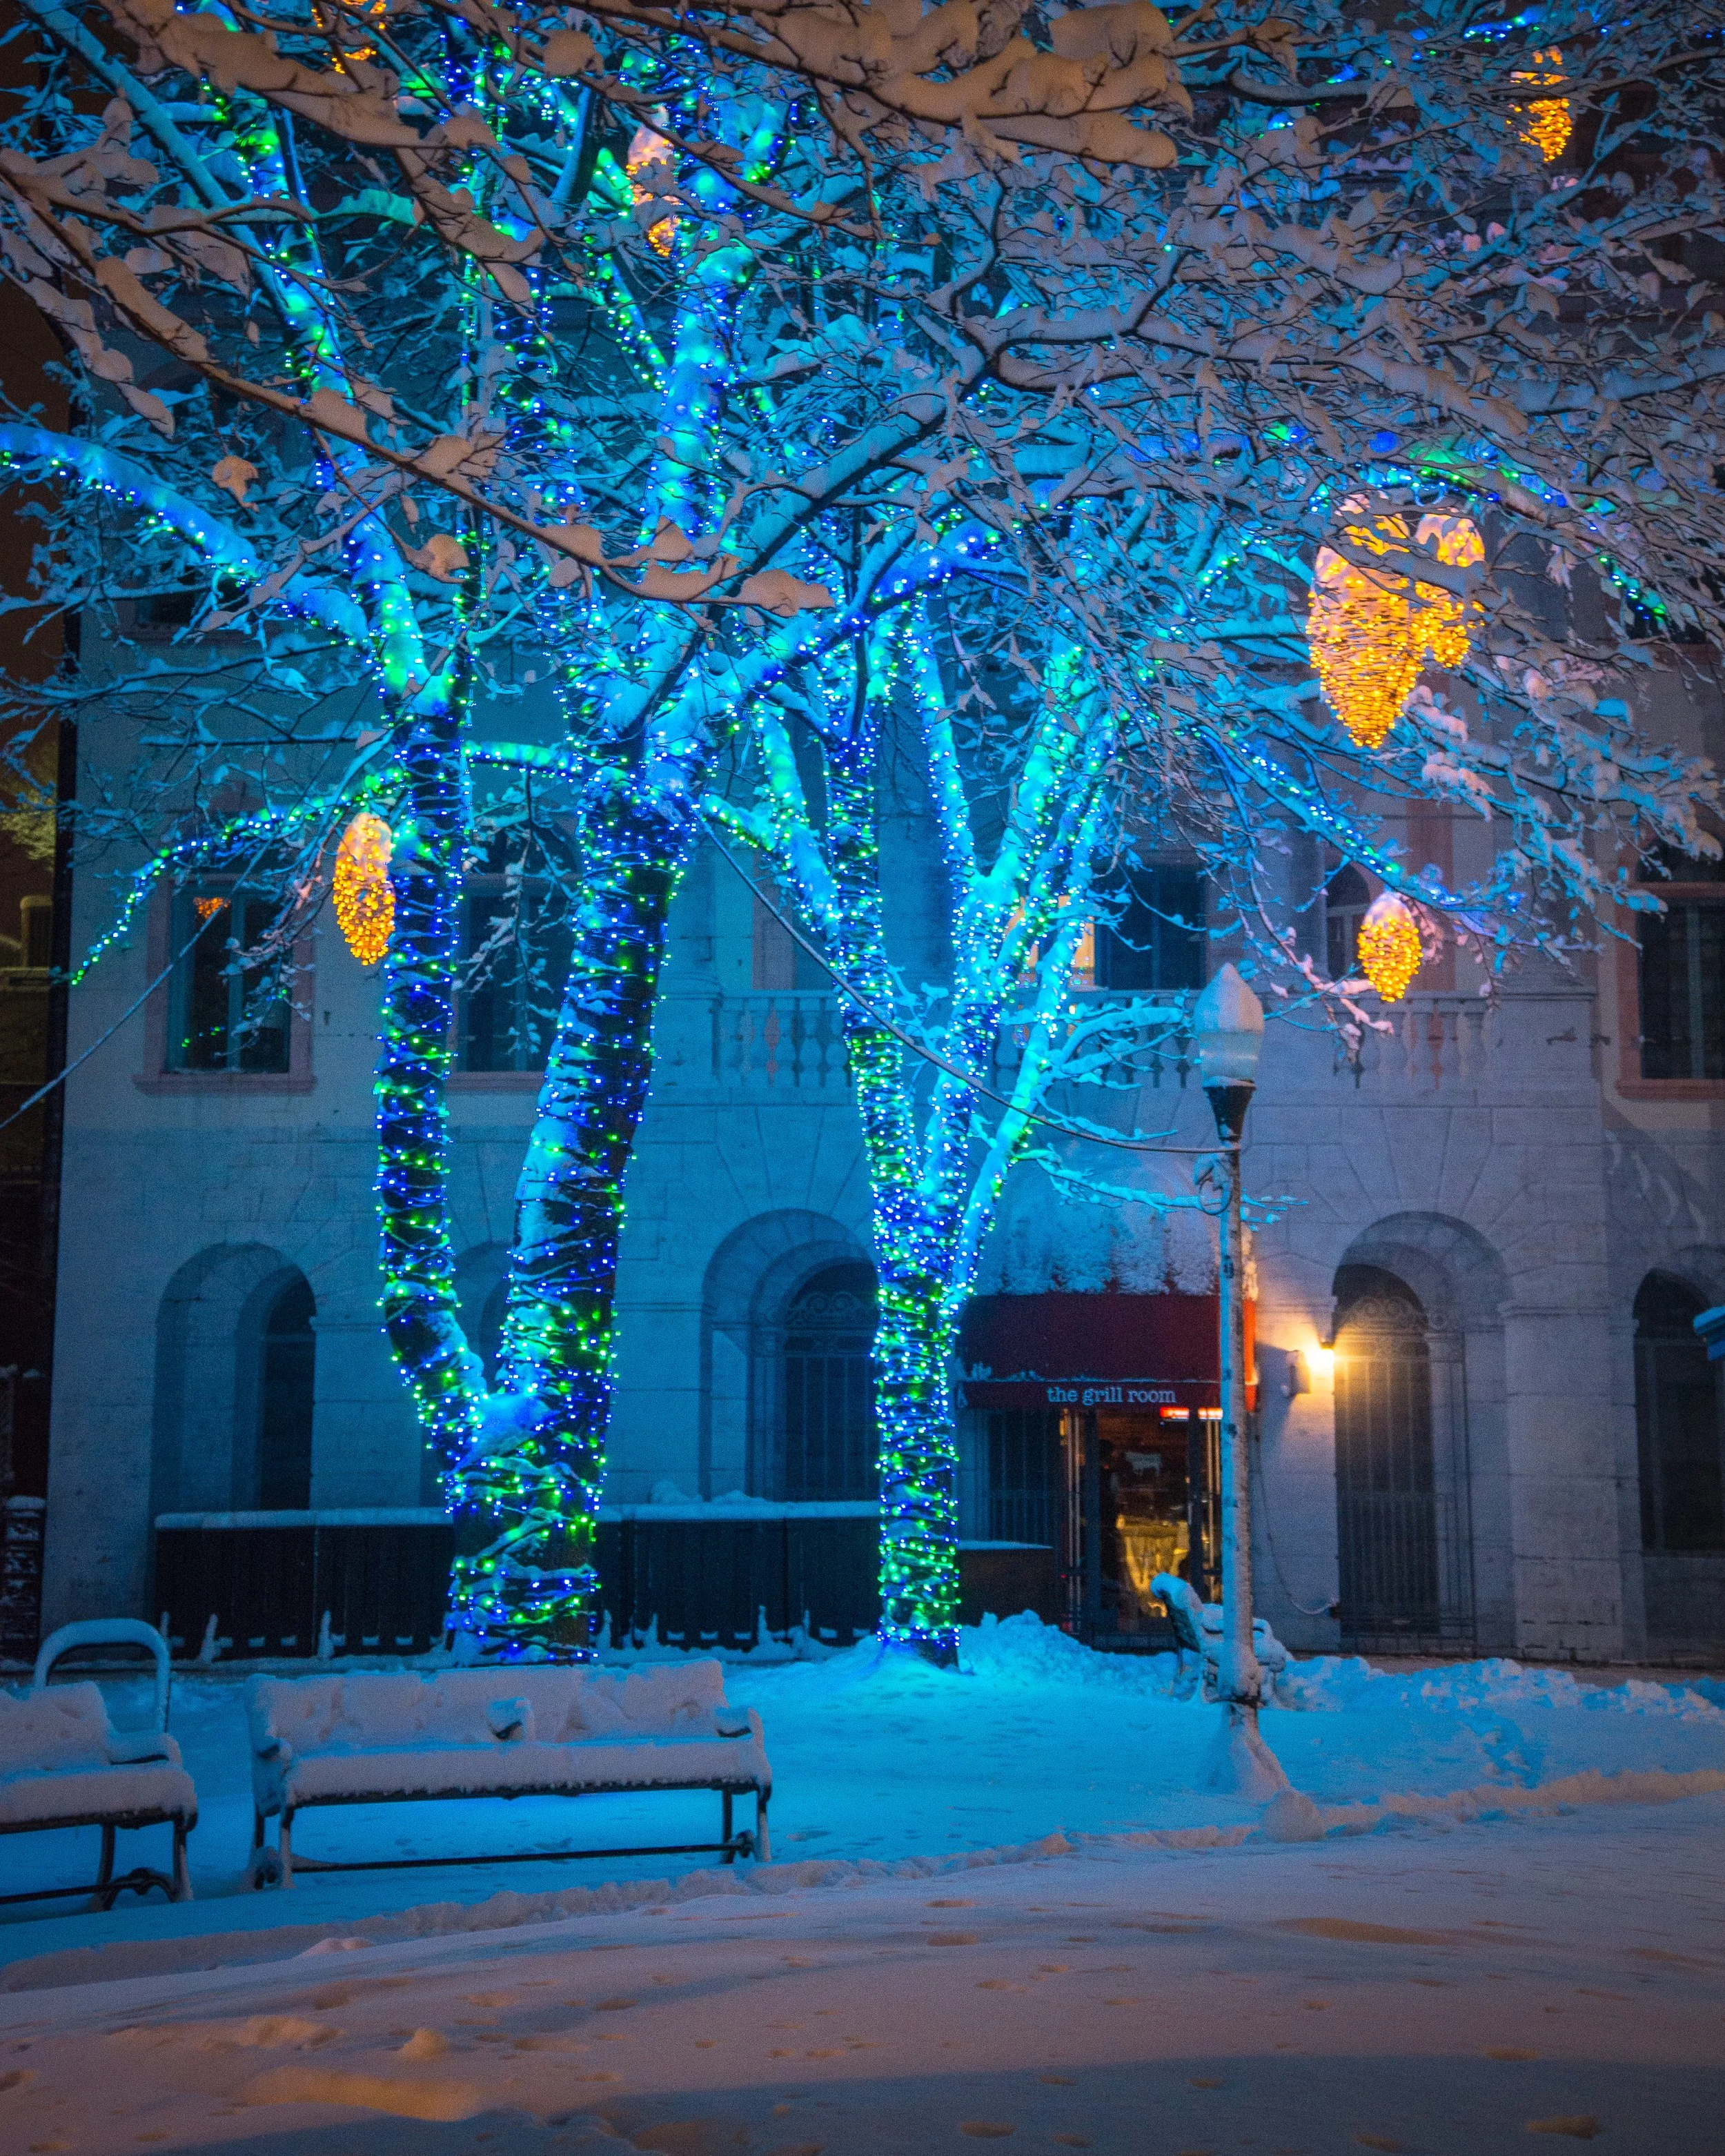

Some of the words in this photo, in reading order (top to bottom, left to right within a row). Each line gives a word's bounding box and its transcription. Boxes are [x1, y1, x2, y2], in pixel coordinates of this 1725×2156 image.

[1047, 1386, 1078, 1402] the
[1082, 1386, 1123, 1405] grill
[1127, 1389, 1176, 1403] room
